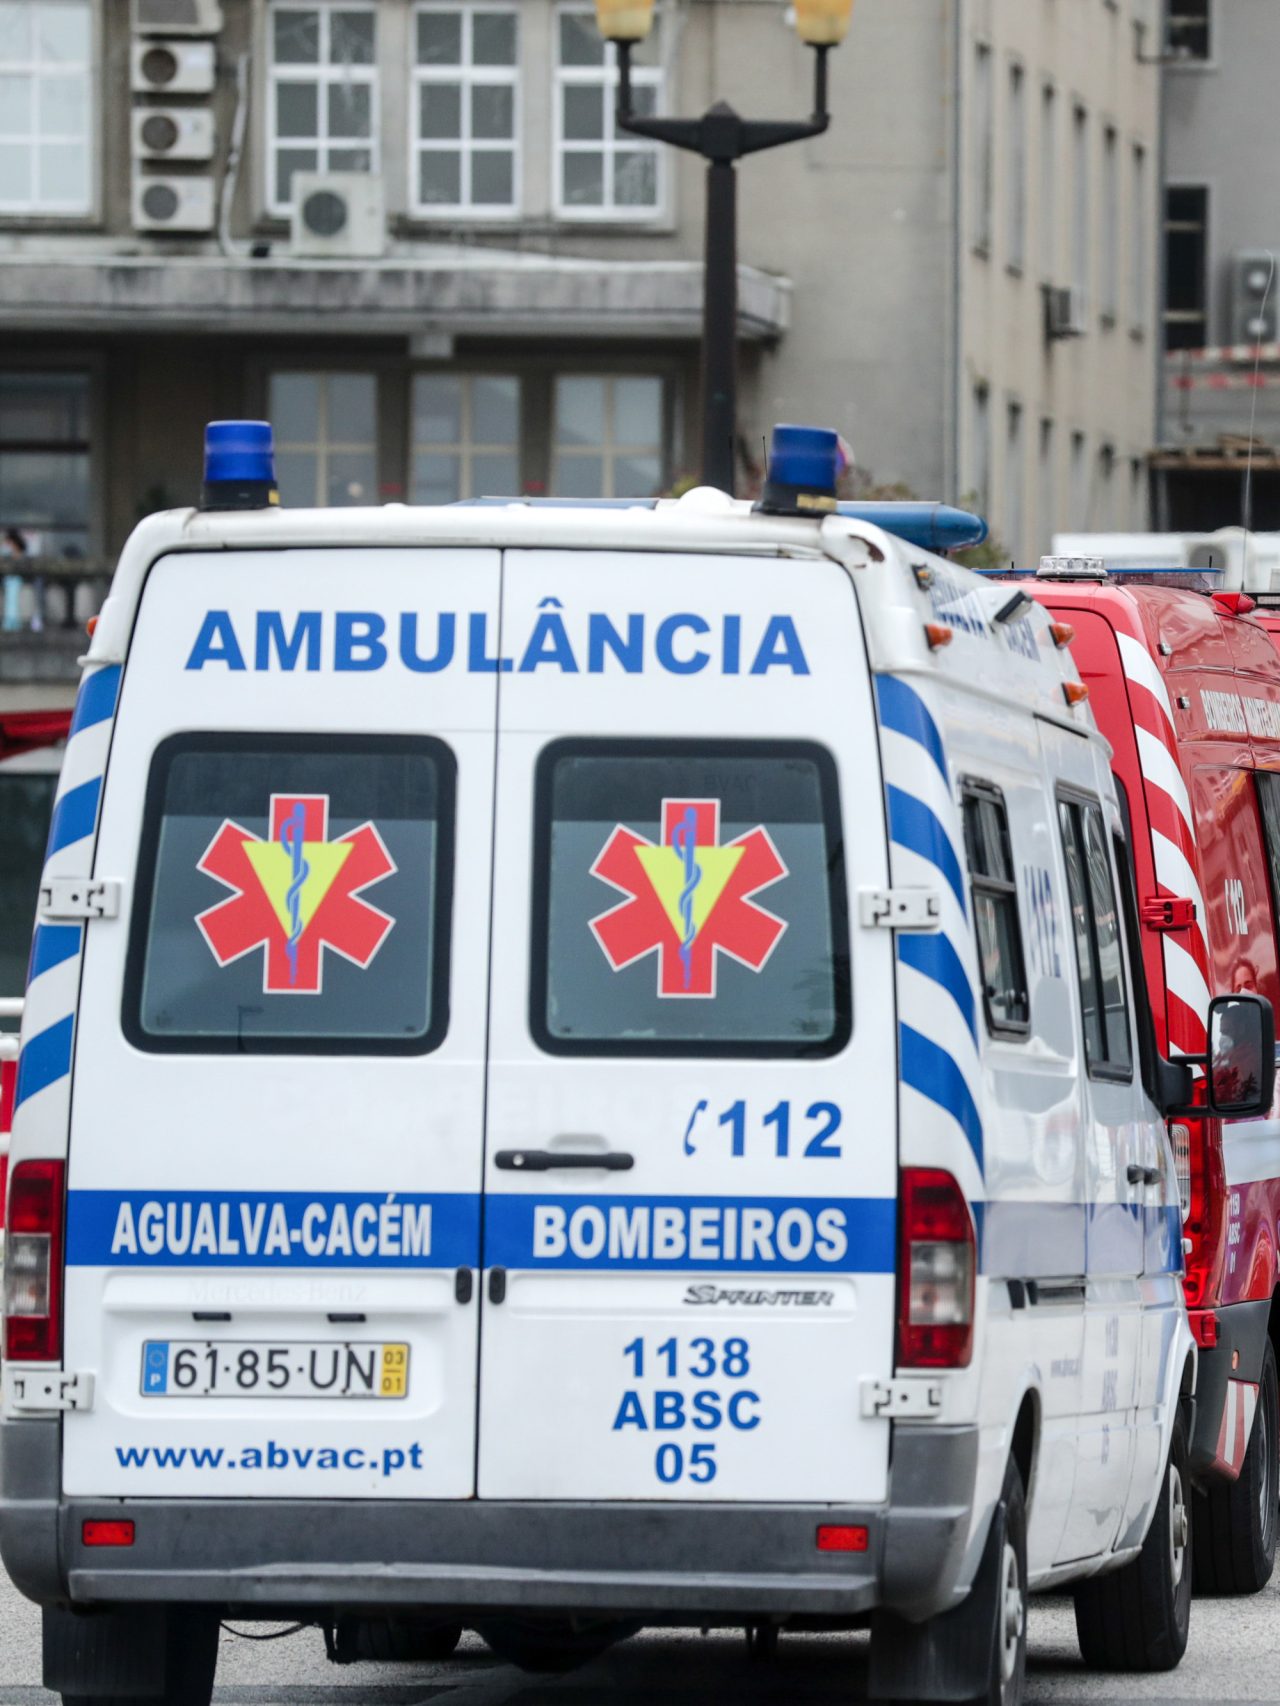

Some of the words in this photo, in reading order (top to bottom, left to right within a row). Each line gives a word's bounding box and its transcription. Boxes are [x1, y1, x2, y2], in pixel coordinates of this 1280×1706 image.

[185, 596, 809, 675] AMBULÂNCIA
[716, 1100, 843, 1159] 112
[112, 1195, 432, 1258] AGUALVA-CACÉM
[532, 1206, 848, 1262] BOMBEIROS
[383, 1351, 405, 1366] 03
[623, 1336, 751, 1379] 1138
[150, 1373, 161, 1387] P
[382, 1376, 402, 1392] 01
[612, 1390, 762, 1432] ABSC
[115, 1440, 424, 1477] www.abvac.pt
[654, 1442, 718, 1484] 05
